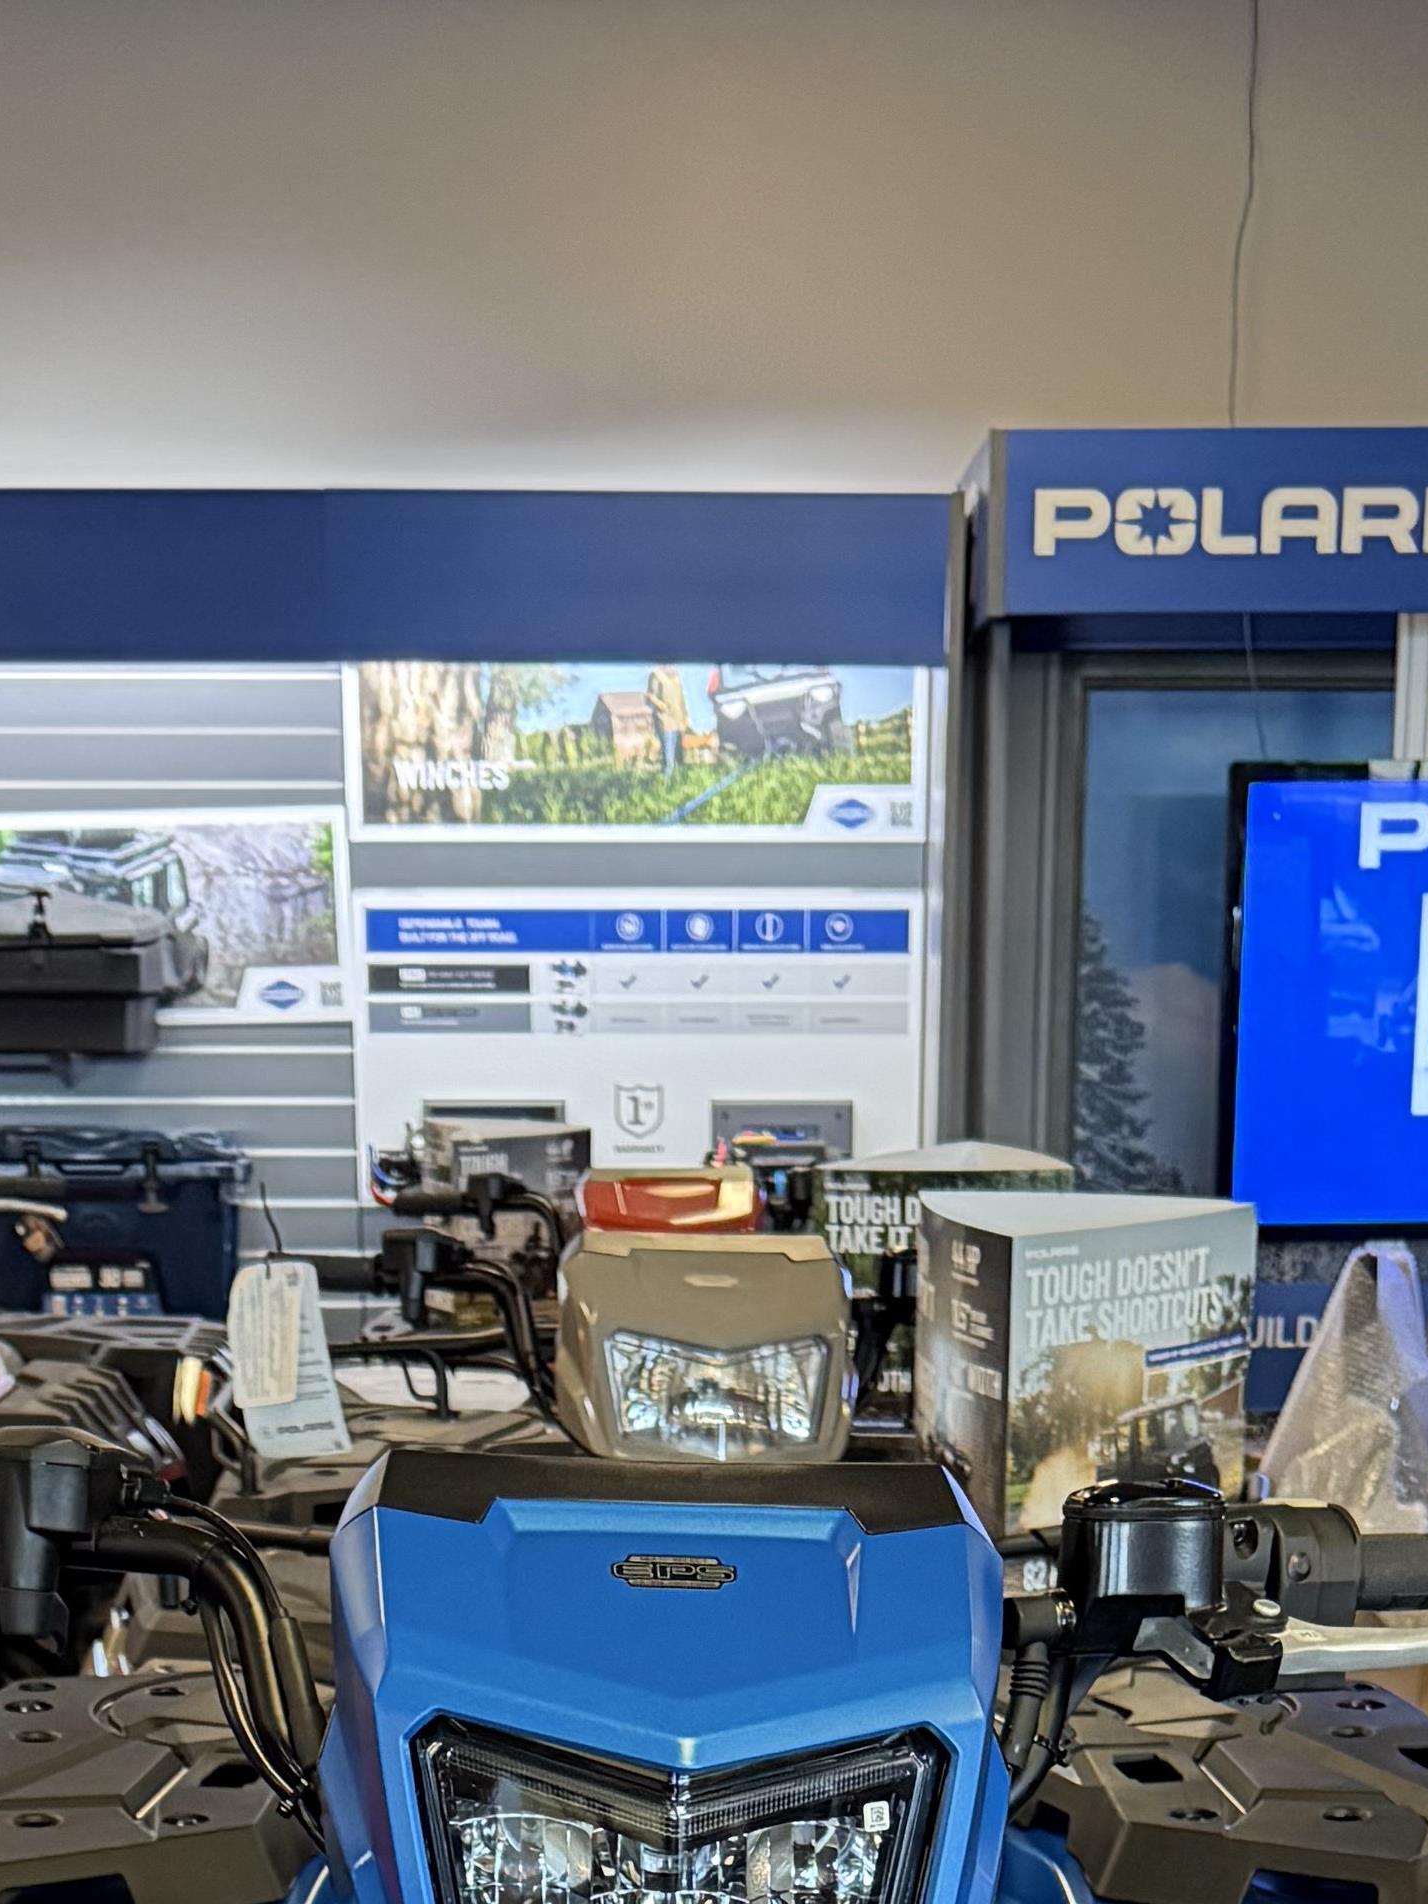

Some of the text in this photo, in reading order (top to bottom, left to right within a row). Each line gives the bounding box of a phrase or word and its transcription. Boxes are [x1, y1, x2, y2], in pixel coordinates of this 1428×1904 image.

[393, 759, 510, 791] WINCHES
[825, 1195, 904, 1226] TOUGH
[825, 1224, 885, 1255] TAKE
[1025, 1247, 1210, 1307] TOUGH DOESN'T
[1025, 1303, 1093, 1349] TAKE
[1097, 1283, 1224, 1340] SHORTCUTS
[1247, 1313, 1322, 1350] UILD
